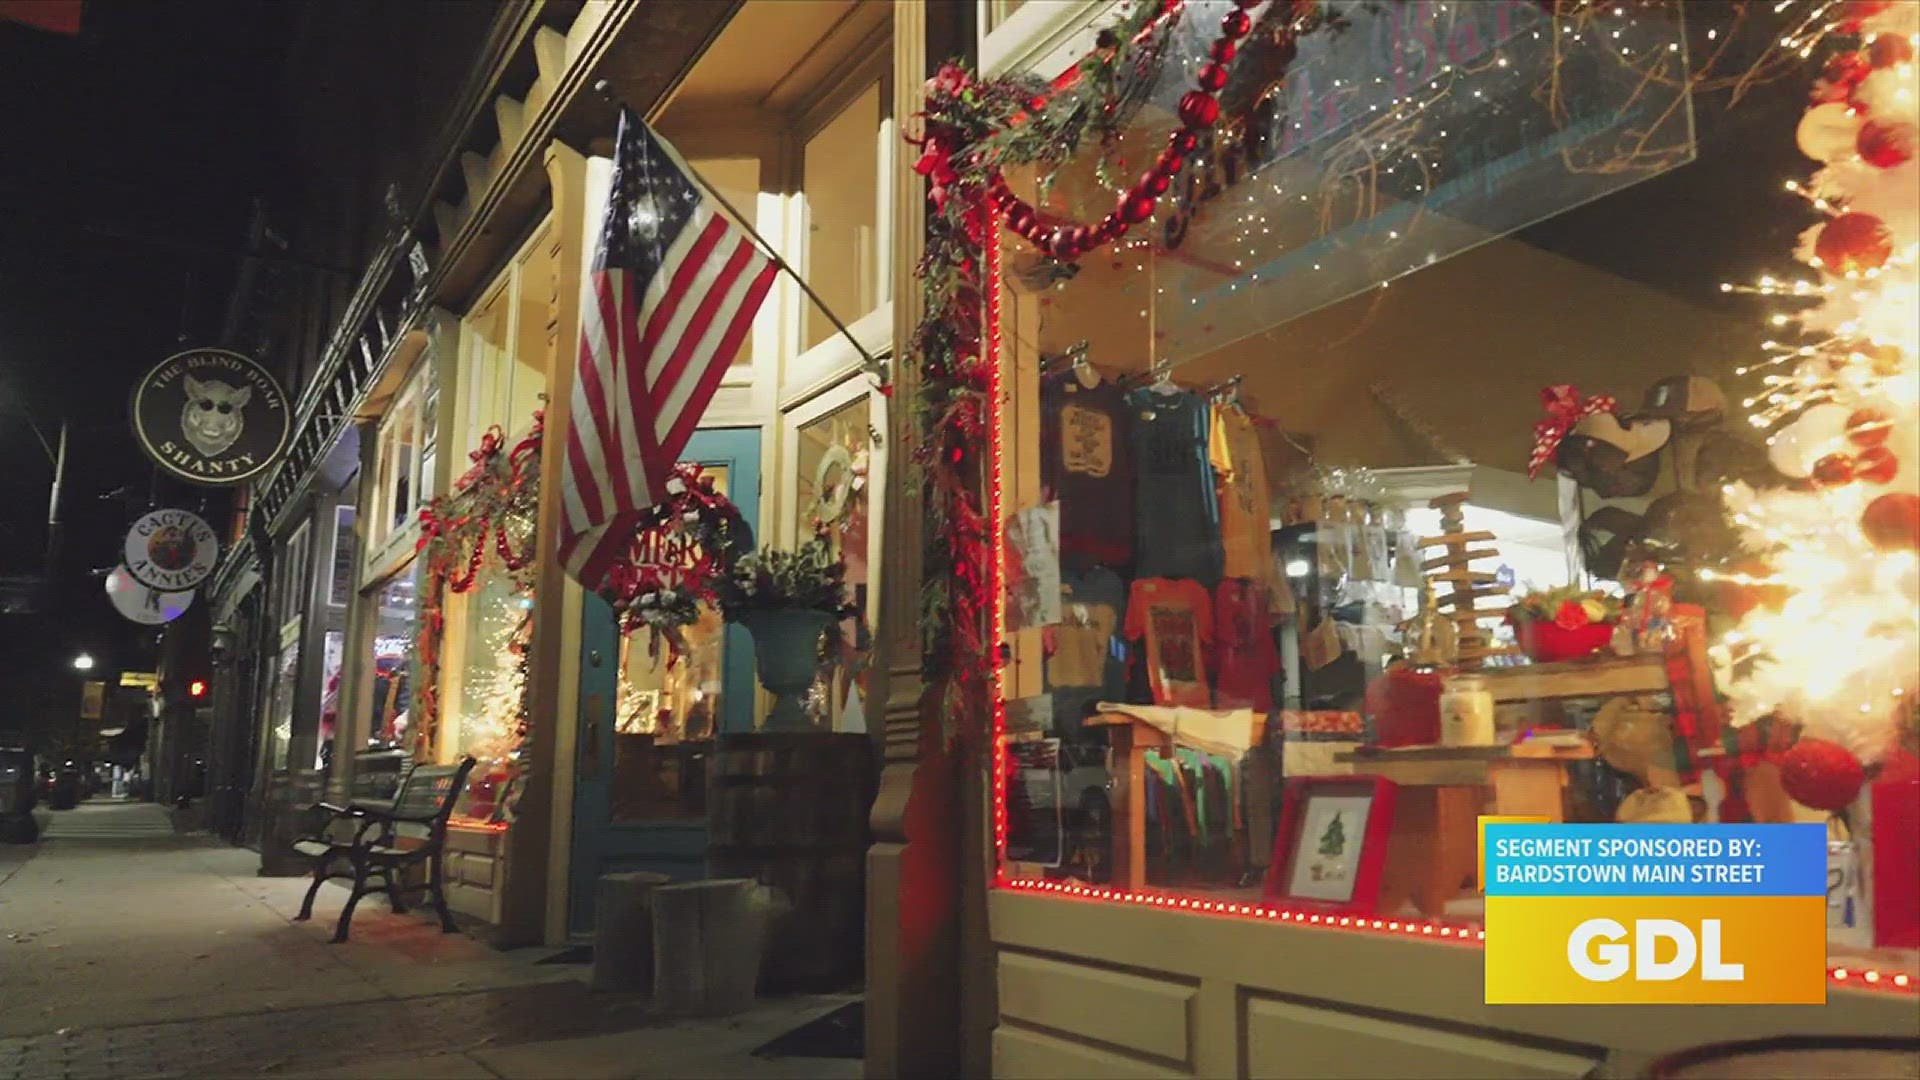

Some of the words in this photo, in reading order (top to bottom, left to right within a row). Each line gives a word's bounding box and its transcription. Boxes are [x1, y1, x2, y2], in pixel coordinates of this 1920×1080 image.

[152, 363, 181, 390] THE
[188, 354, 243, 371] BLIND
[246, 370, 280, 410] BOAR
[159, 440, 255, 474] SHANTY
[137, 512, 211, 543] CACTUS
